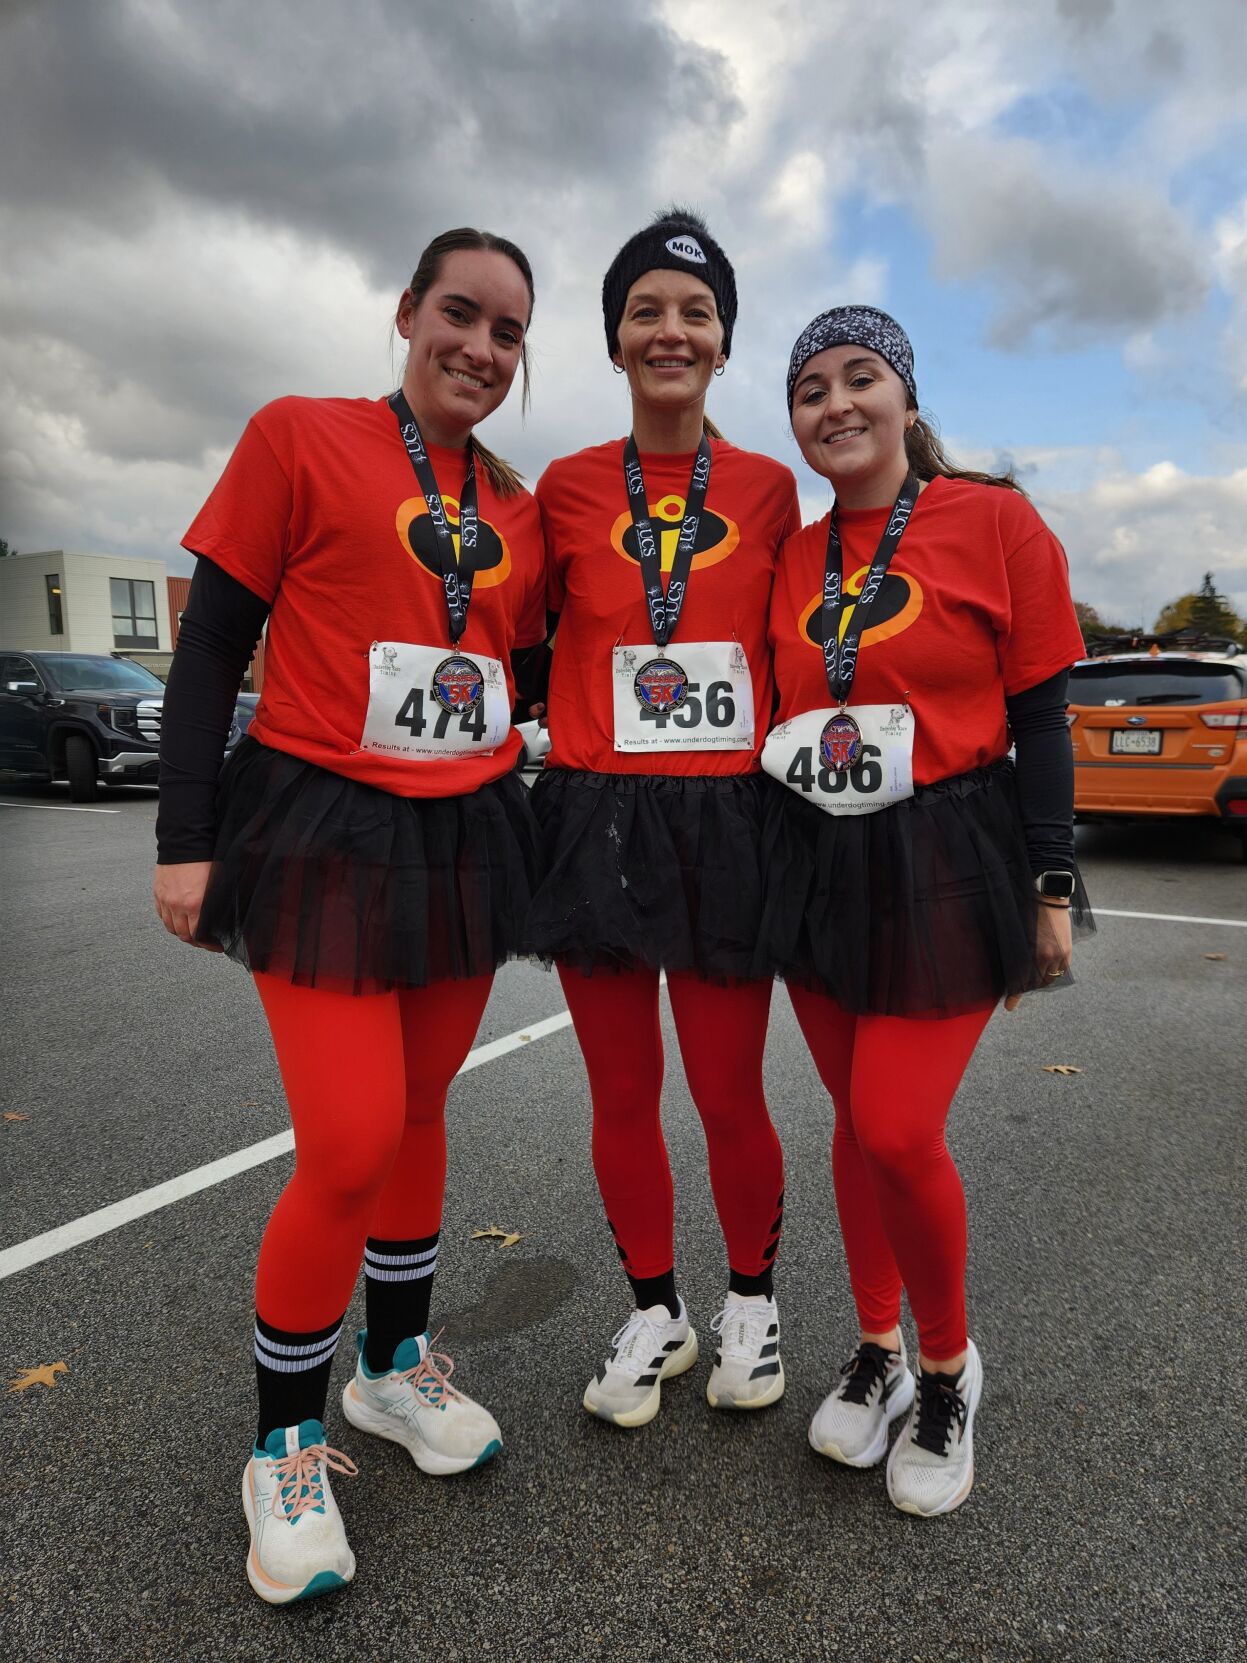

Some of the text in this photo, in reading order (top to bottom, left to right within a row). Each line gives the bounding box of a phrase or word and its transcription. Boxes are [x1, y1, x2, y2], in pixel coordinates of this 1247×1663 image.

[672, 242, 702, 259] MOK
[401, 423, 421, 454] UCS
[629, 467, 644, 495] UCS
[693, 455, 709, 481] UCS
[425, 494, 445, 525] UCS
[889, 508, 912, 536] UCS
[463, 516, 478, 548] UCS
[639, 528, 656, 557] UCS
[680, 515, 697, 541] UCS
[444, 573, 459, 608] UCS
[666, 581, 683, 612] UCS
[824, 572, 839, 600] UCS
[862, 574, 883, 604] UCS
[652, 597, 665, 630] UCS
[823, 638, 836, 672] UCS
[841, 647, 858, 681] UCS
[449, 684, 471, 704] 5K
[650, 685, 673, 704] 5K
[395, 687, 487, 742] 474
[371, 741, 401, 751] Results
[663, 736, 748, 744] www.underdogtiming.com
[831, 742, 849, 763] 5K
[786, 744, 883, 794] 486
